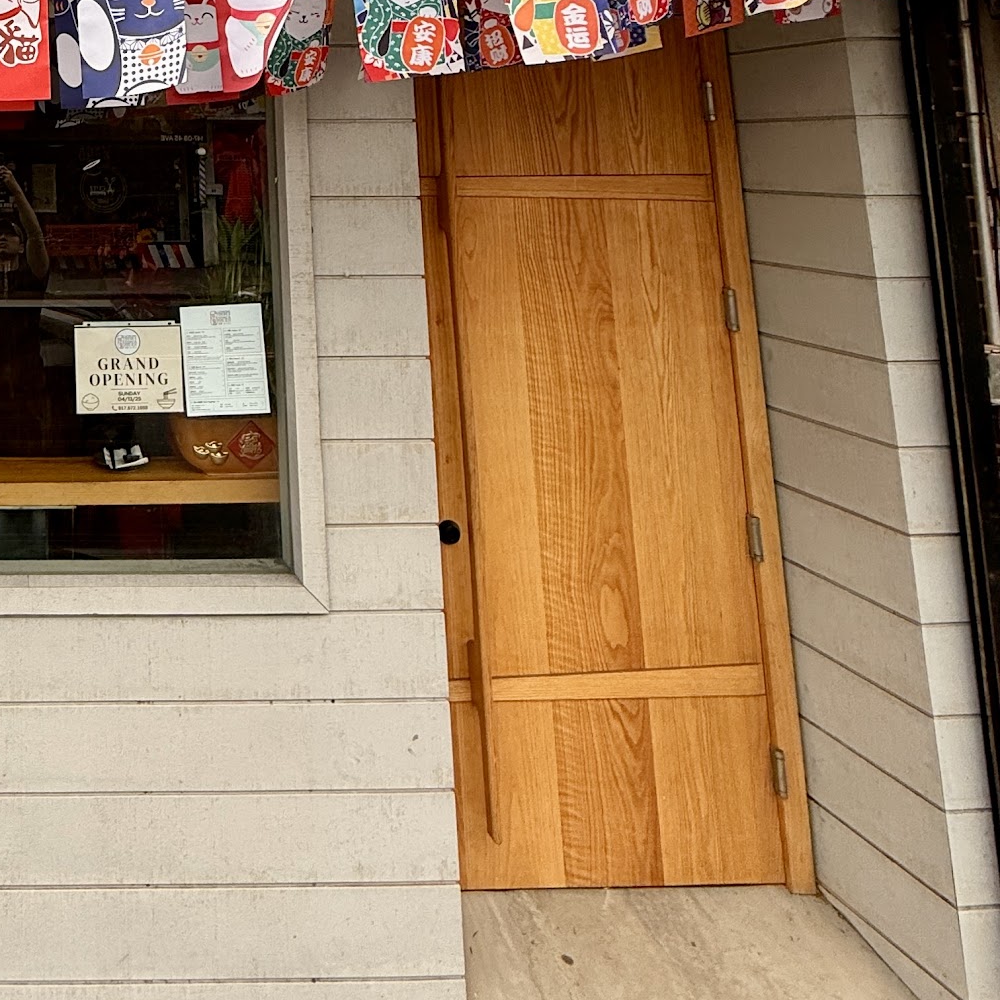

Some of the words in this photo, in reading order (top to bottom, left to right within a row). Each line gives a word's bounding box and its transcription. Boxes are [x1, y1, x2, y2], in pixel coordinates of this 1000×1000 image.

[561, 5, 592, 51] 金运
[409, 21, 437, 68] 安康
[97, 356, 160, 371] GRAND
[89, 372, 169, 387] OPENING
